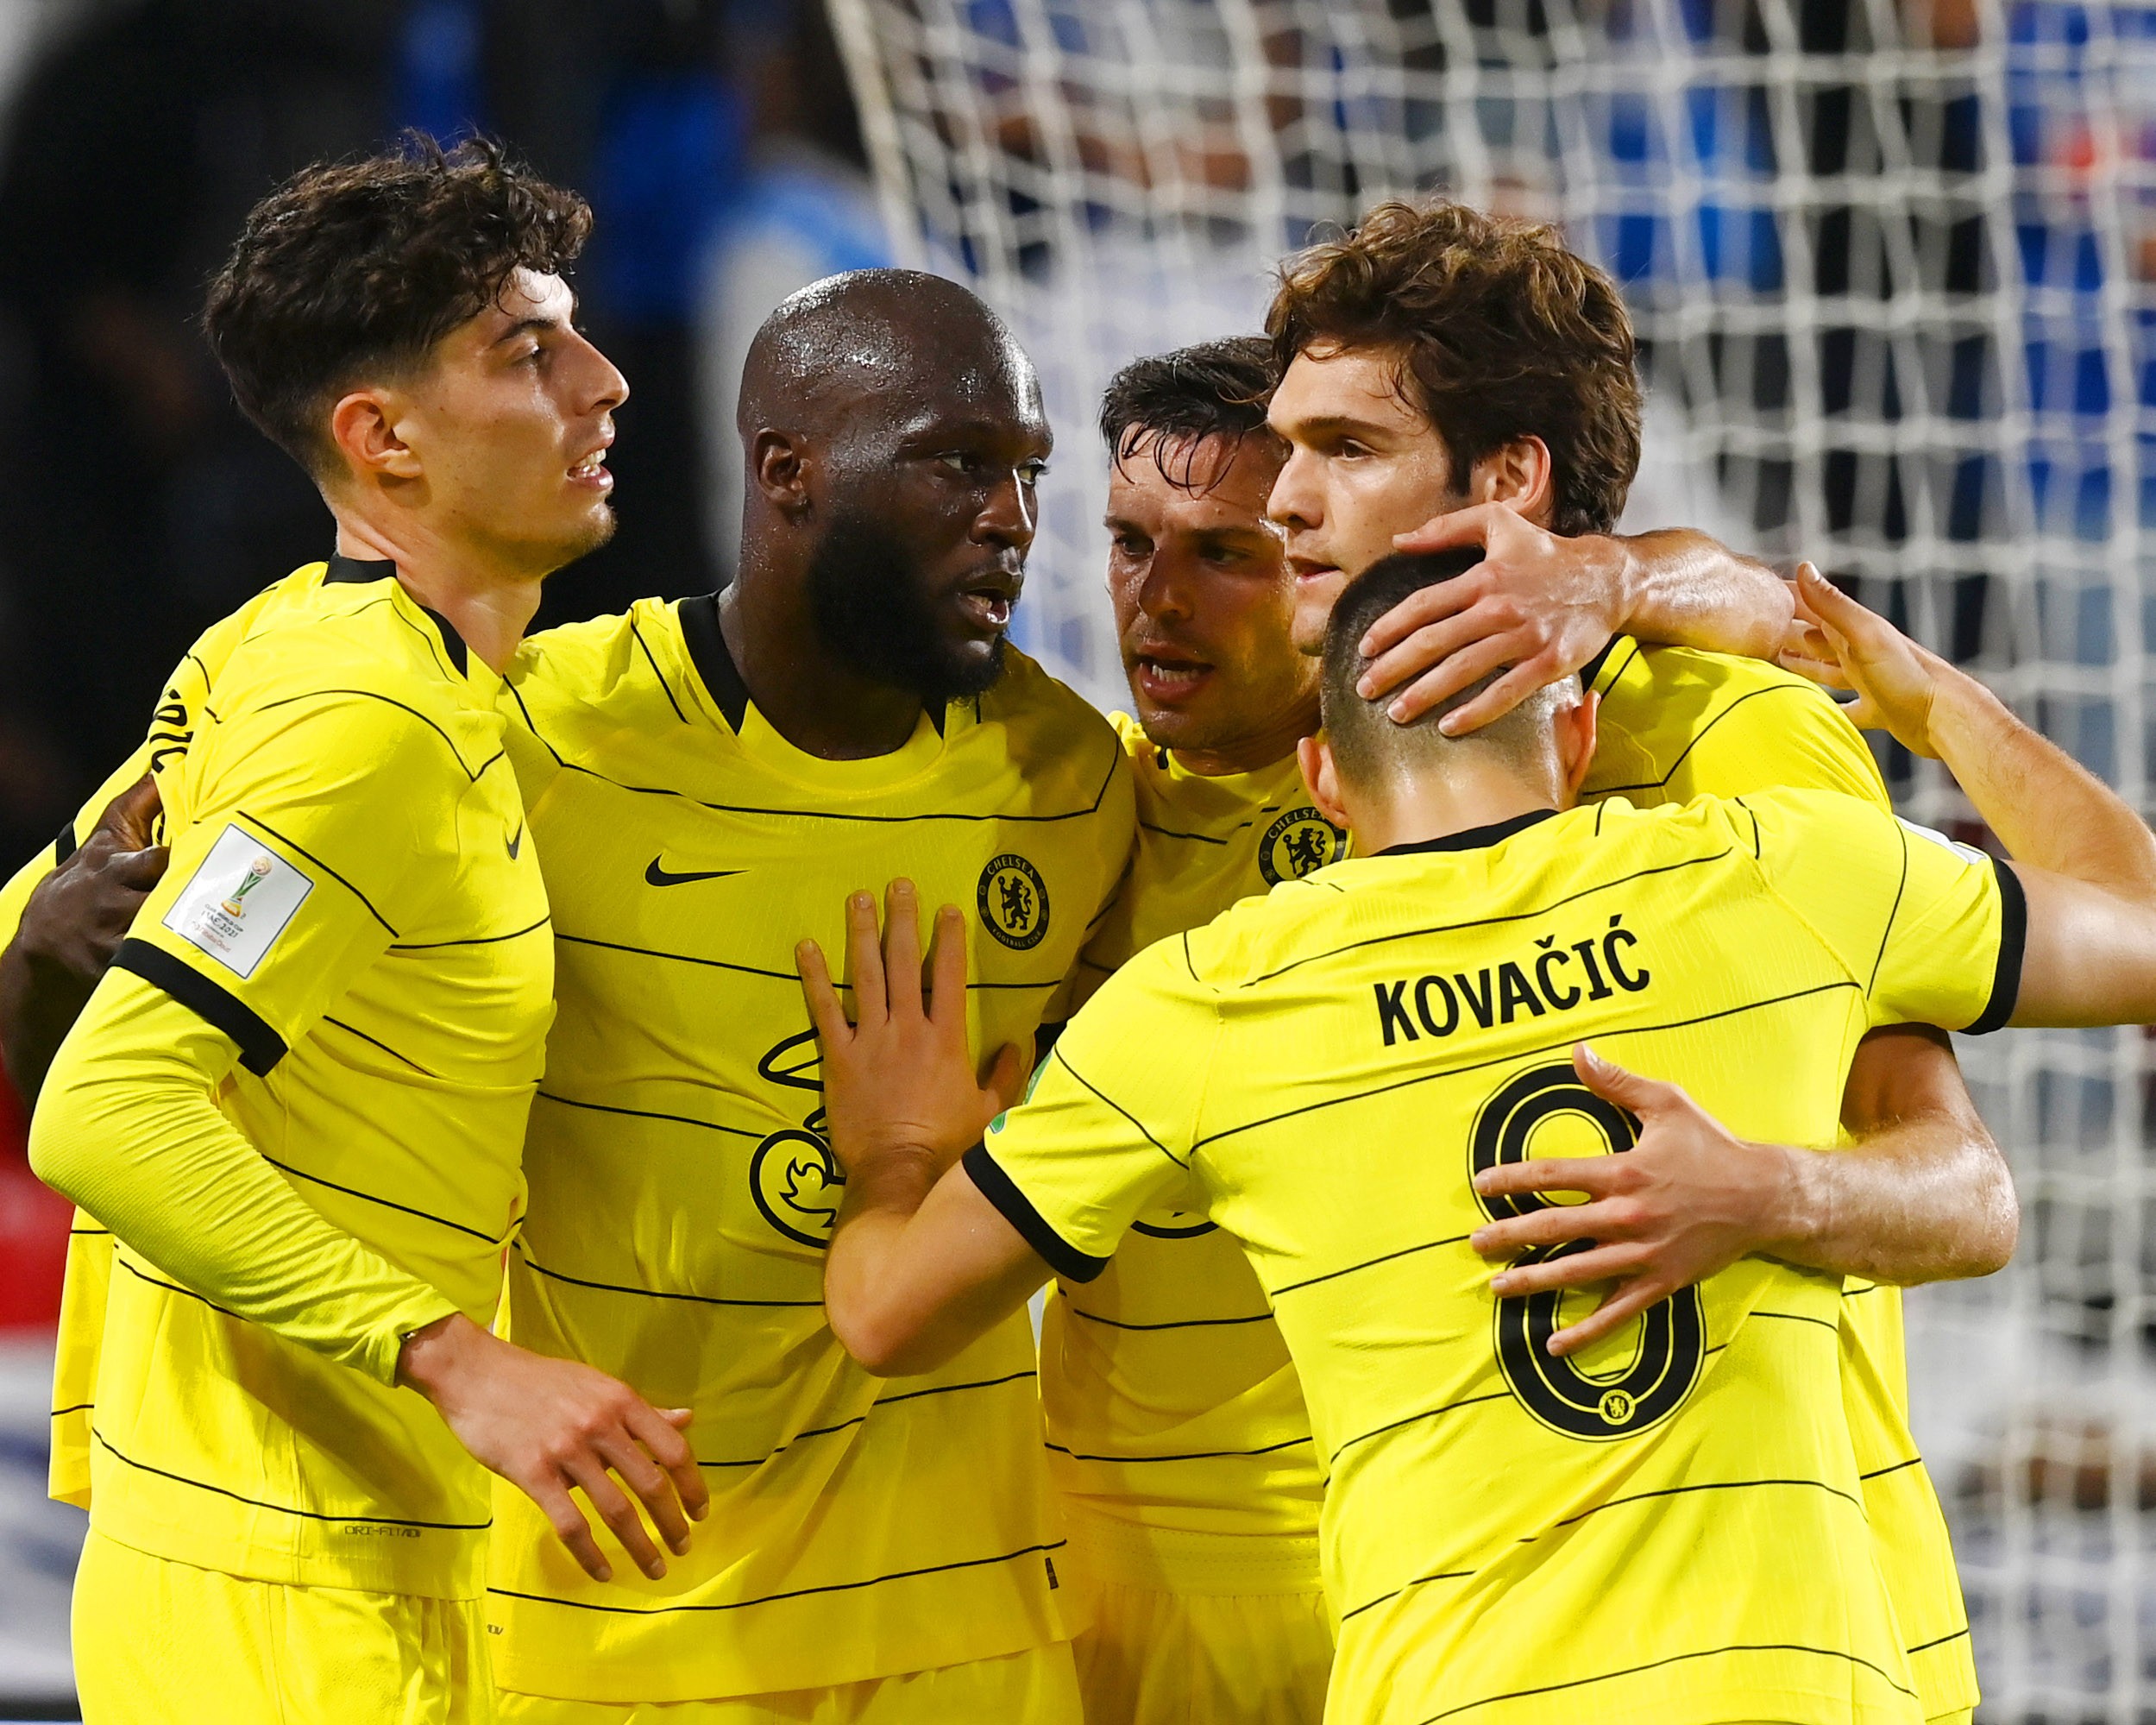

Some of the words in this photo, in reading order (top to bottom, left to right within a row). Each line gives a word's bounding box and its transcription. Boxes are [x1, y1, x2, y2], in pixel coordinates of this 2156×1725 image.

[987, 855, 1034, 878] CHELSEA
[218, 922, 238, 939] 2021
[1373, 913, 1650, 1048] KOVAČIĆ
[1467, 1058, 1707, 1443] 8
